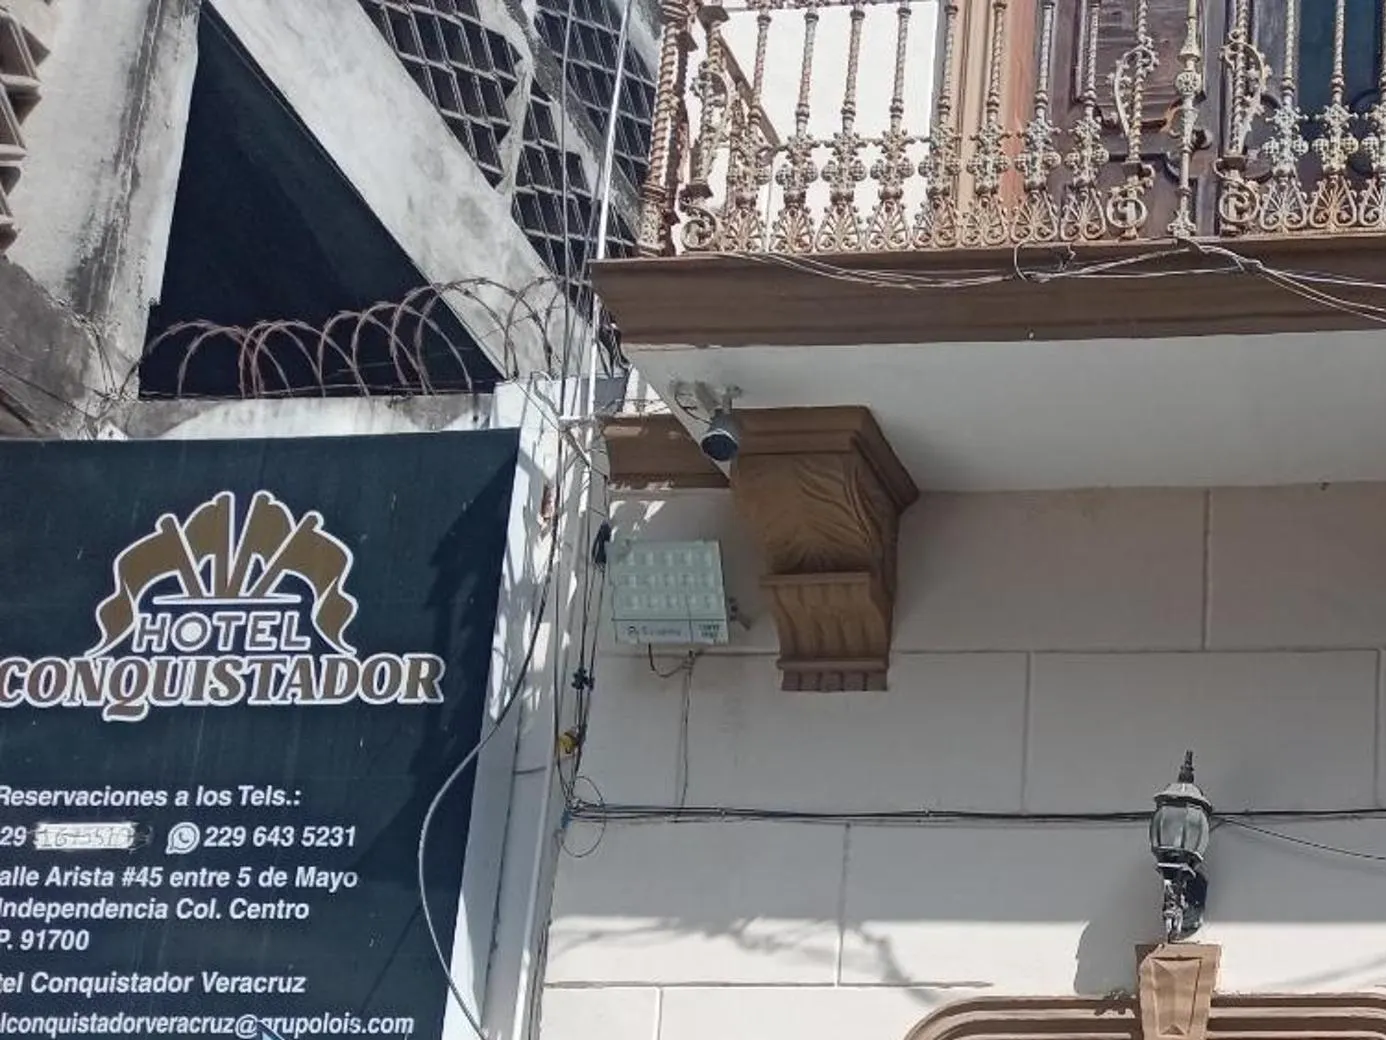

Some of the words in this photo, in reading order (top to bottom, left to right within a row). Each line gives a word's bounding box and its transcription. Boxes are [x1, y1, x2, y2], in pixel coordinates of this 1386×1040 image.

[132, 610, 312, 652] HOTEL
[0, 653, 445, 721] CONQUISTADOR
[0, 785, 167, 806] Reservaciones
[175, 790, 190, 806] a
[196, 786, 233, 807] los
[238, 785, 302, 807] Tels.:
[204, 826, 246, 847] 229
[253, 826, 296, 847] 643
[300, 826, 356, 847] 5231
[44, 866, 115, 888] Arista
[122, 867, 163, 887] #45
[169, 868, 231, 889] entre
[237, 867, 251, 887] 5
[258, 867, 288, 887] de
[295, 867, 358, 893] Mayo
[175, 898, 222, 920] Col.
[229, 898, 310, 921] Centro
[19, 929, 90, 951] 91700
[31, 971, 193, 998] Conquistador
[202, 972, 306, 993] Veracruz
